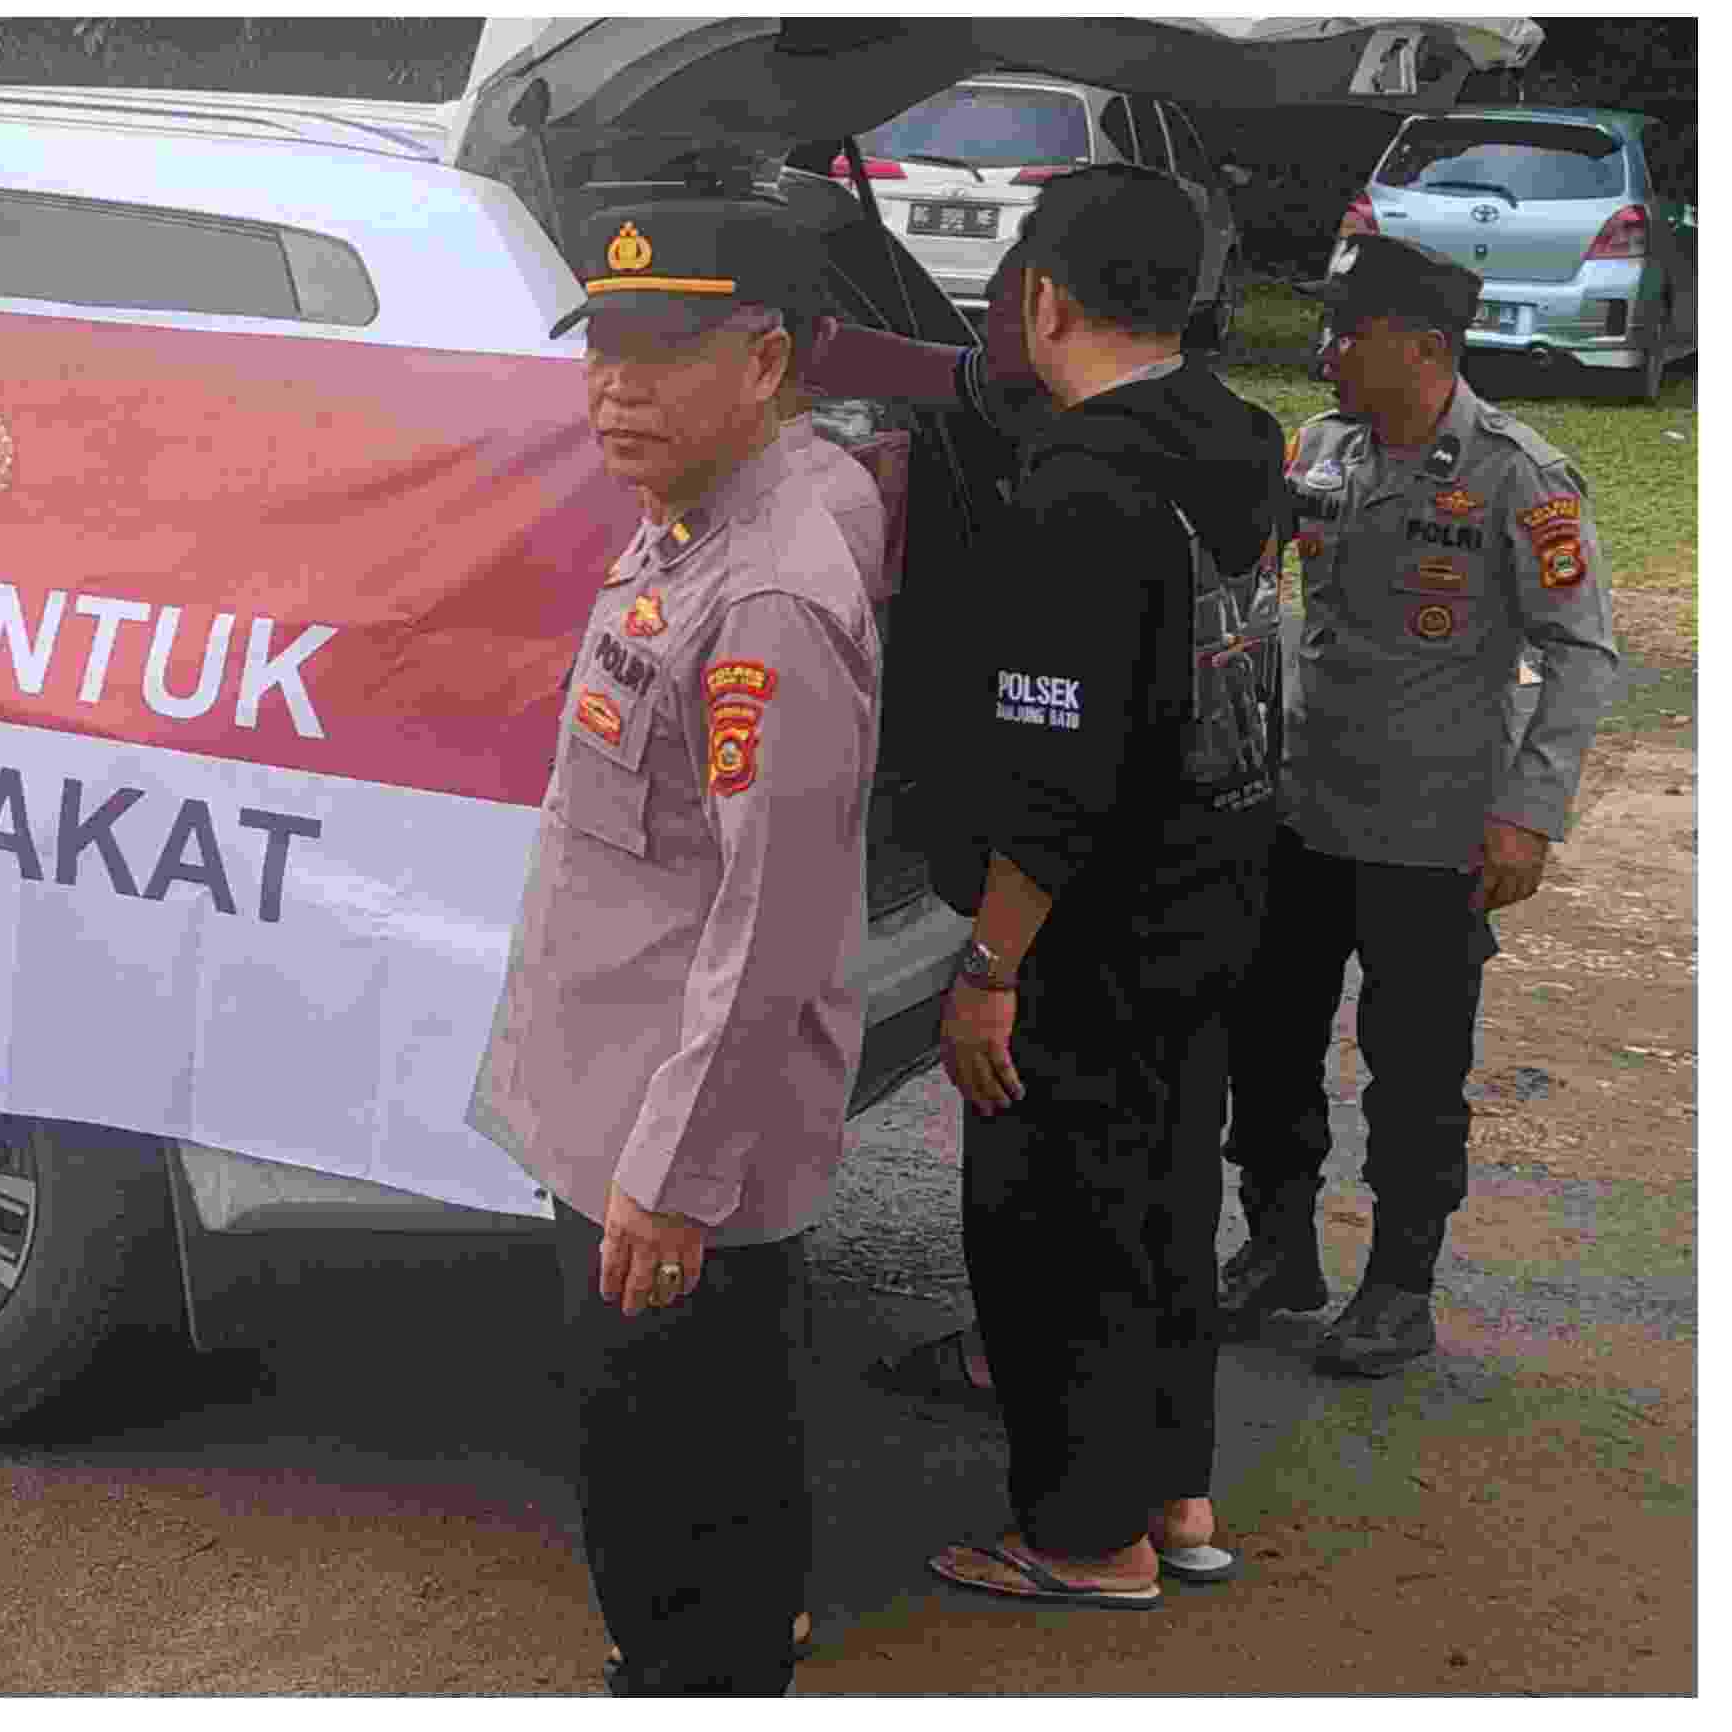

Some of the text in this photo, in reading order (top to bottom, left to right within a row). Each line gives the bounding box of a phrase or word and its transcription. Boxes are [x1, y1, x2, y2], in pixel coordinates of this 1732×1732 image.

[1405, 519, 1482, 549] POLRI
[594, 633, 657, 697] POLRI
[997, 670, 1080, 709] POLSEK
